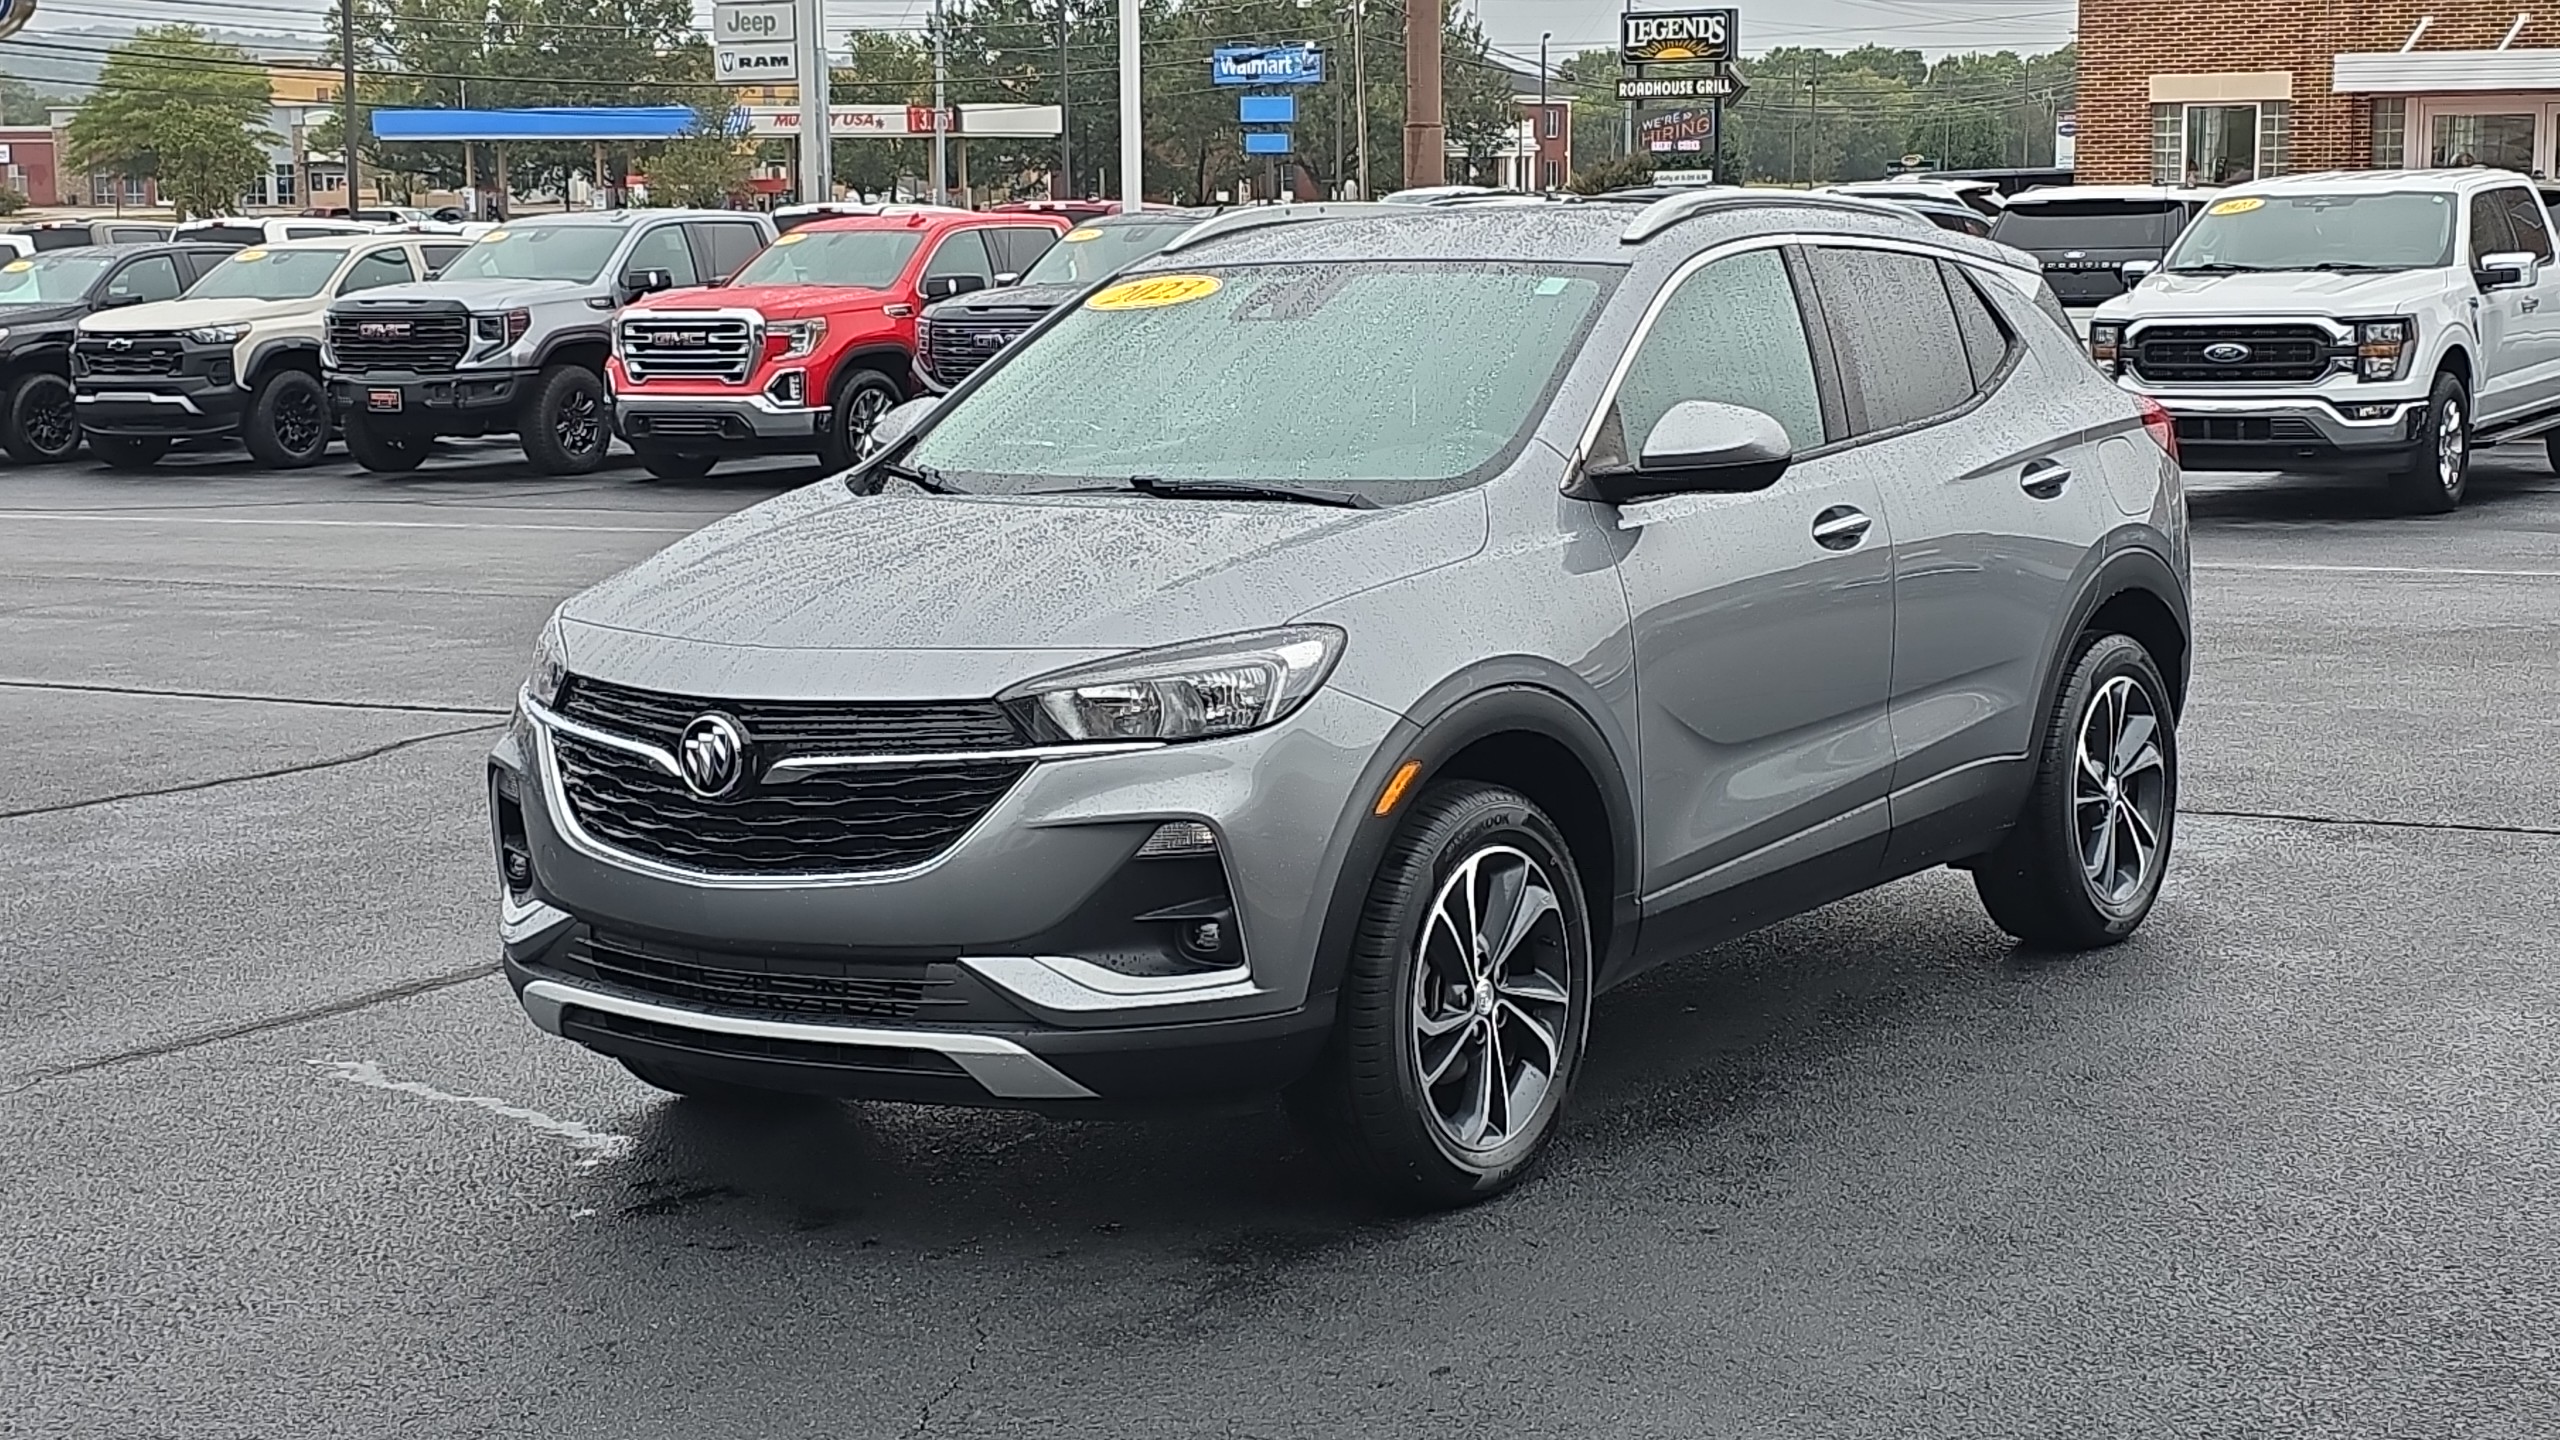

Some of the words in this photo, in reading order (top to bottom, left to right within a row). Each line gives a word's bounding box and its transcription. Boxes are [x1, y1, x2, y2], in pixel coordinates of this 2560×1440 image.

[727, 10, 777, 36] Jeep
[1625, 15, 1726, 47] LEGENDS
[738, 56, 789, 68] RAM
[1619, 80, 1694, 97] ROADHOUSE
[1696, 79, 1732, 95] GRILL
[843, 113, 875, 126] USA
[1642, 112, 1681, 131] WE'RE
[1641, 117, 1710, 147] HIRING
[1100, 280, 1206, 305] 2023
[360, 323, 411, 336] GMC
[653, 331, 706, 346] GMC
